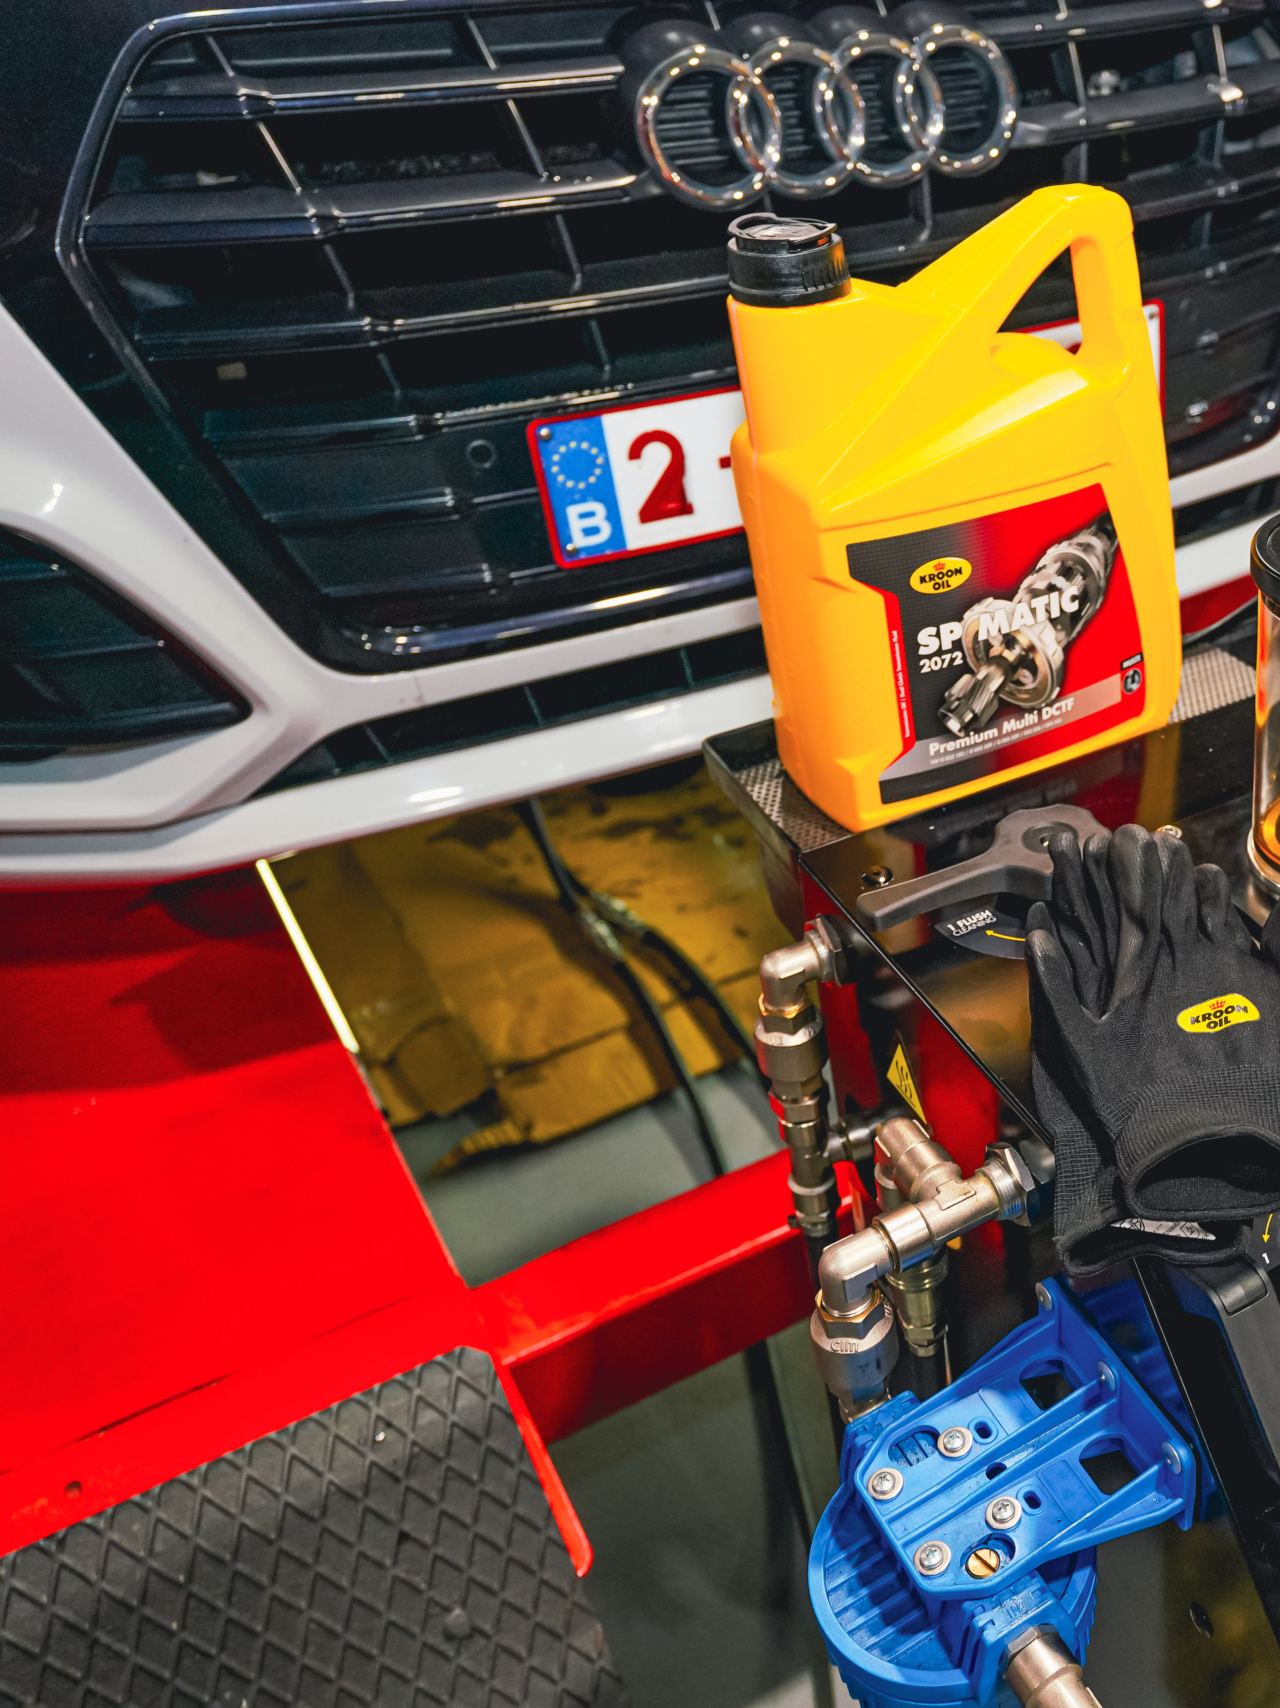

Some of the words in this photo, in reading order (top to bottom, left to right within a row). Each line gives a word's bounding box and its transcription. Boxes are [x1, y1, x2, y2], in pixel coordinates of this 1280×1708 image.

[566, 501, 612, 548] B
[919, 566, 963, 584] KROON
[932, 579, 951, 591] OIL
[917, 621, 963, 655] SP
[977, 585, 1080, 641] MATIC
[919, 651, 963, 673] 2072
[929, 728, 998, 756] Premium
[1002, 710, 1038, 734] Multi
[1042, 697, 1075, 721] DCTF
[947, 923, 956, 931] 1
[956, 909, 993, 928] FLUSH
[952, 916, 997, 937] CLEANING
[1190, 1004, 1249, 1025] KROON
[1206, 1016, 1231, 1029] OIL
[1261, 1252, 1270, 1265] 1
